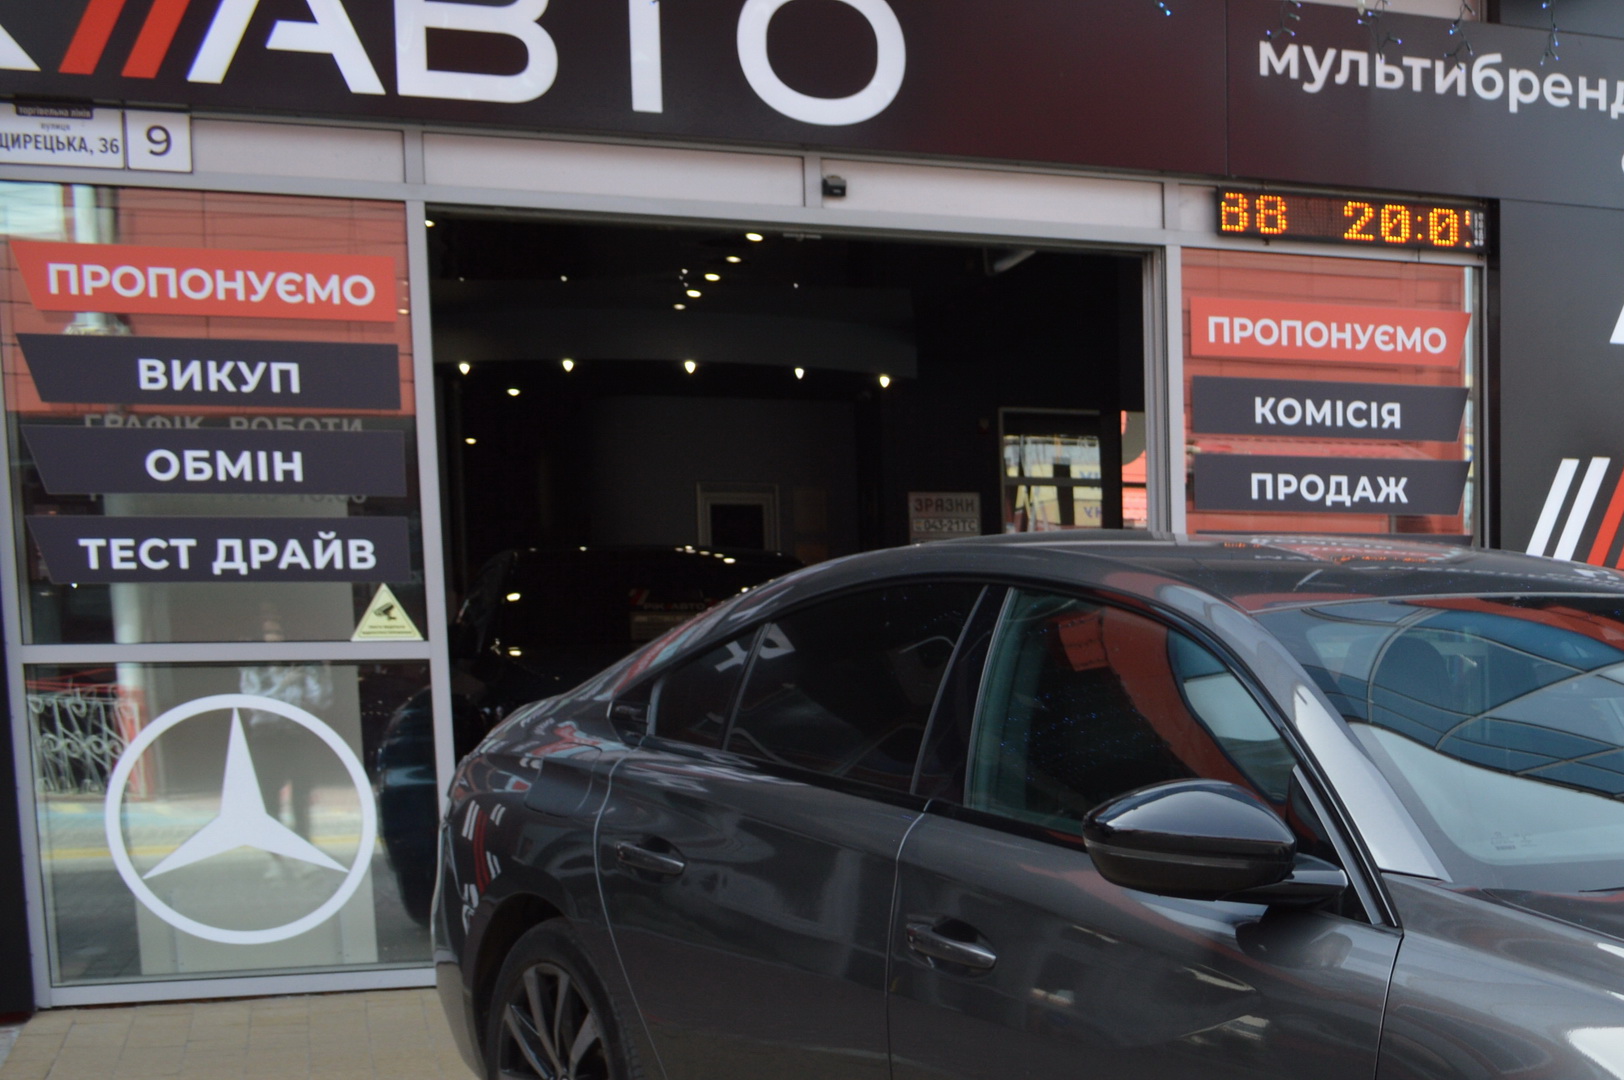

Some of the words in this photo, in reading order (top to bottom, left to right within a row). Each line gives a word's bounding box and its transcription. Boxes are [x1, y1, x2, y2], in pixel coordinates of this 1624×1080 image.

[100, 138, 120, 154] 36
[146, 125, 172, 156] 9
[47, 262, 375, 306] ПРОПОНУЄМО
[1208, 315, 1447, 354] ПРОПОНУЄМО
[138, 358, 300, 394] ВИКУП
[1254, 396, 1401, 429] КОМІСІЯ
[145, 448, 303, 482] ОБМІН
[1251, 472, 1408, 507] ПРОДАЖ
[79, 538, 197, 571] ТЕСТ
[213, 531, 377, 575] ДРАЙВ
